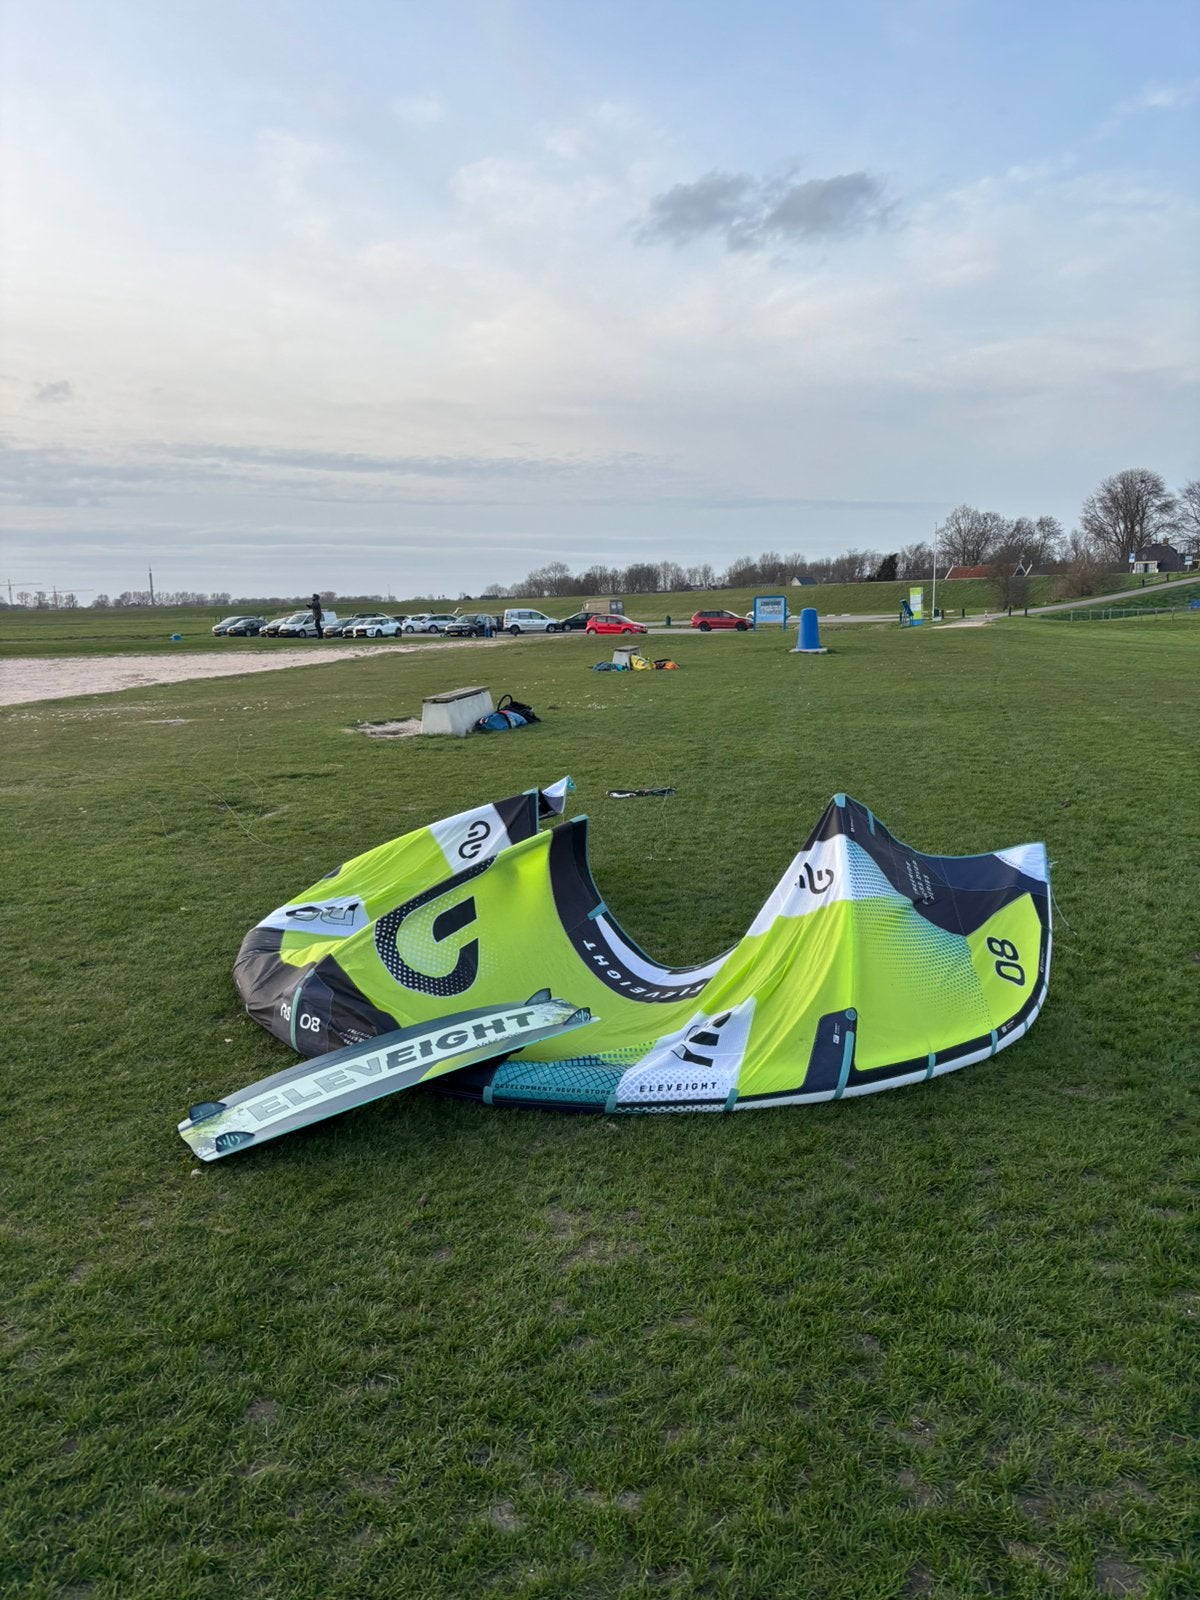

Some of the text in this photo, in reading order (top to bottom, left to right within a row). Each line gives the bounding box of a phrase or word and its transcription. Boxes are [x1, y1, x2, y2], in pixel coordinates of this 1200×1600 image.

[986, 936, 1025, 987] 08
[299, 1013, 321, 1032] 08
[246, 1010, 536, 1122] ELEVEIGHT
[494, 1083, 552, 1093] DEVELOPMENT
[555, 1086, 582, 1094] NEVER
[639, 1081, 718, 1093] ELEVEIGHT
